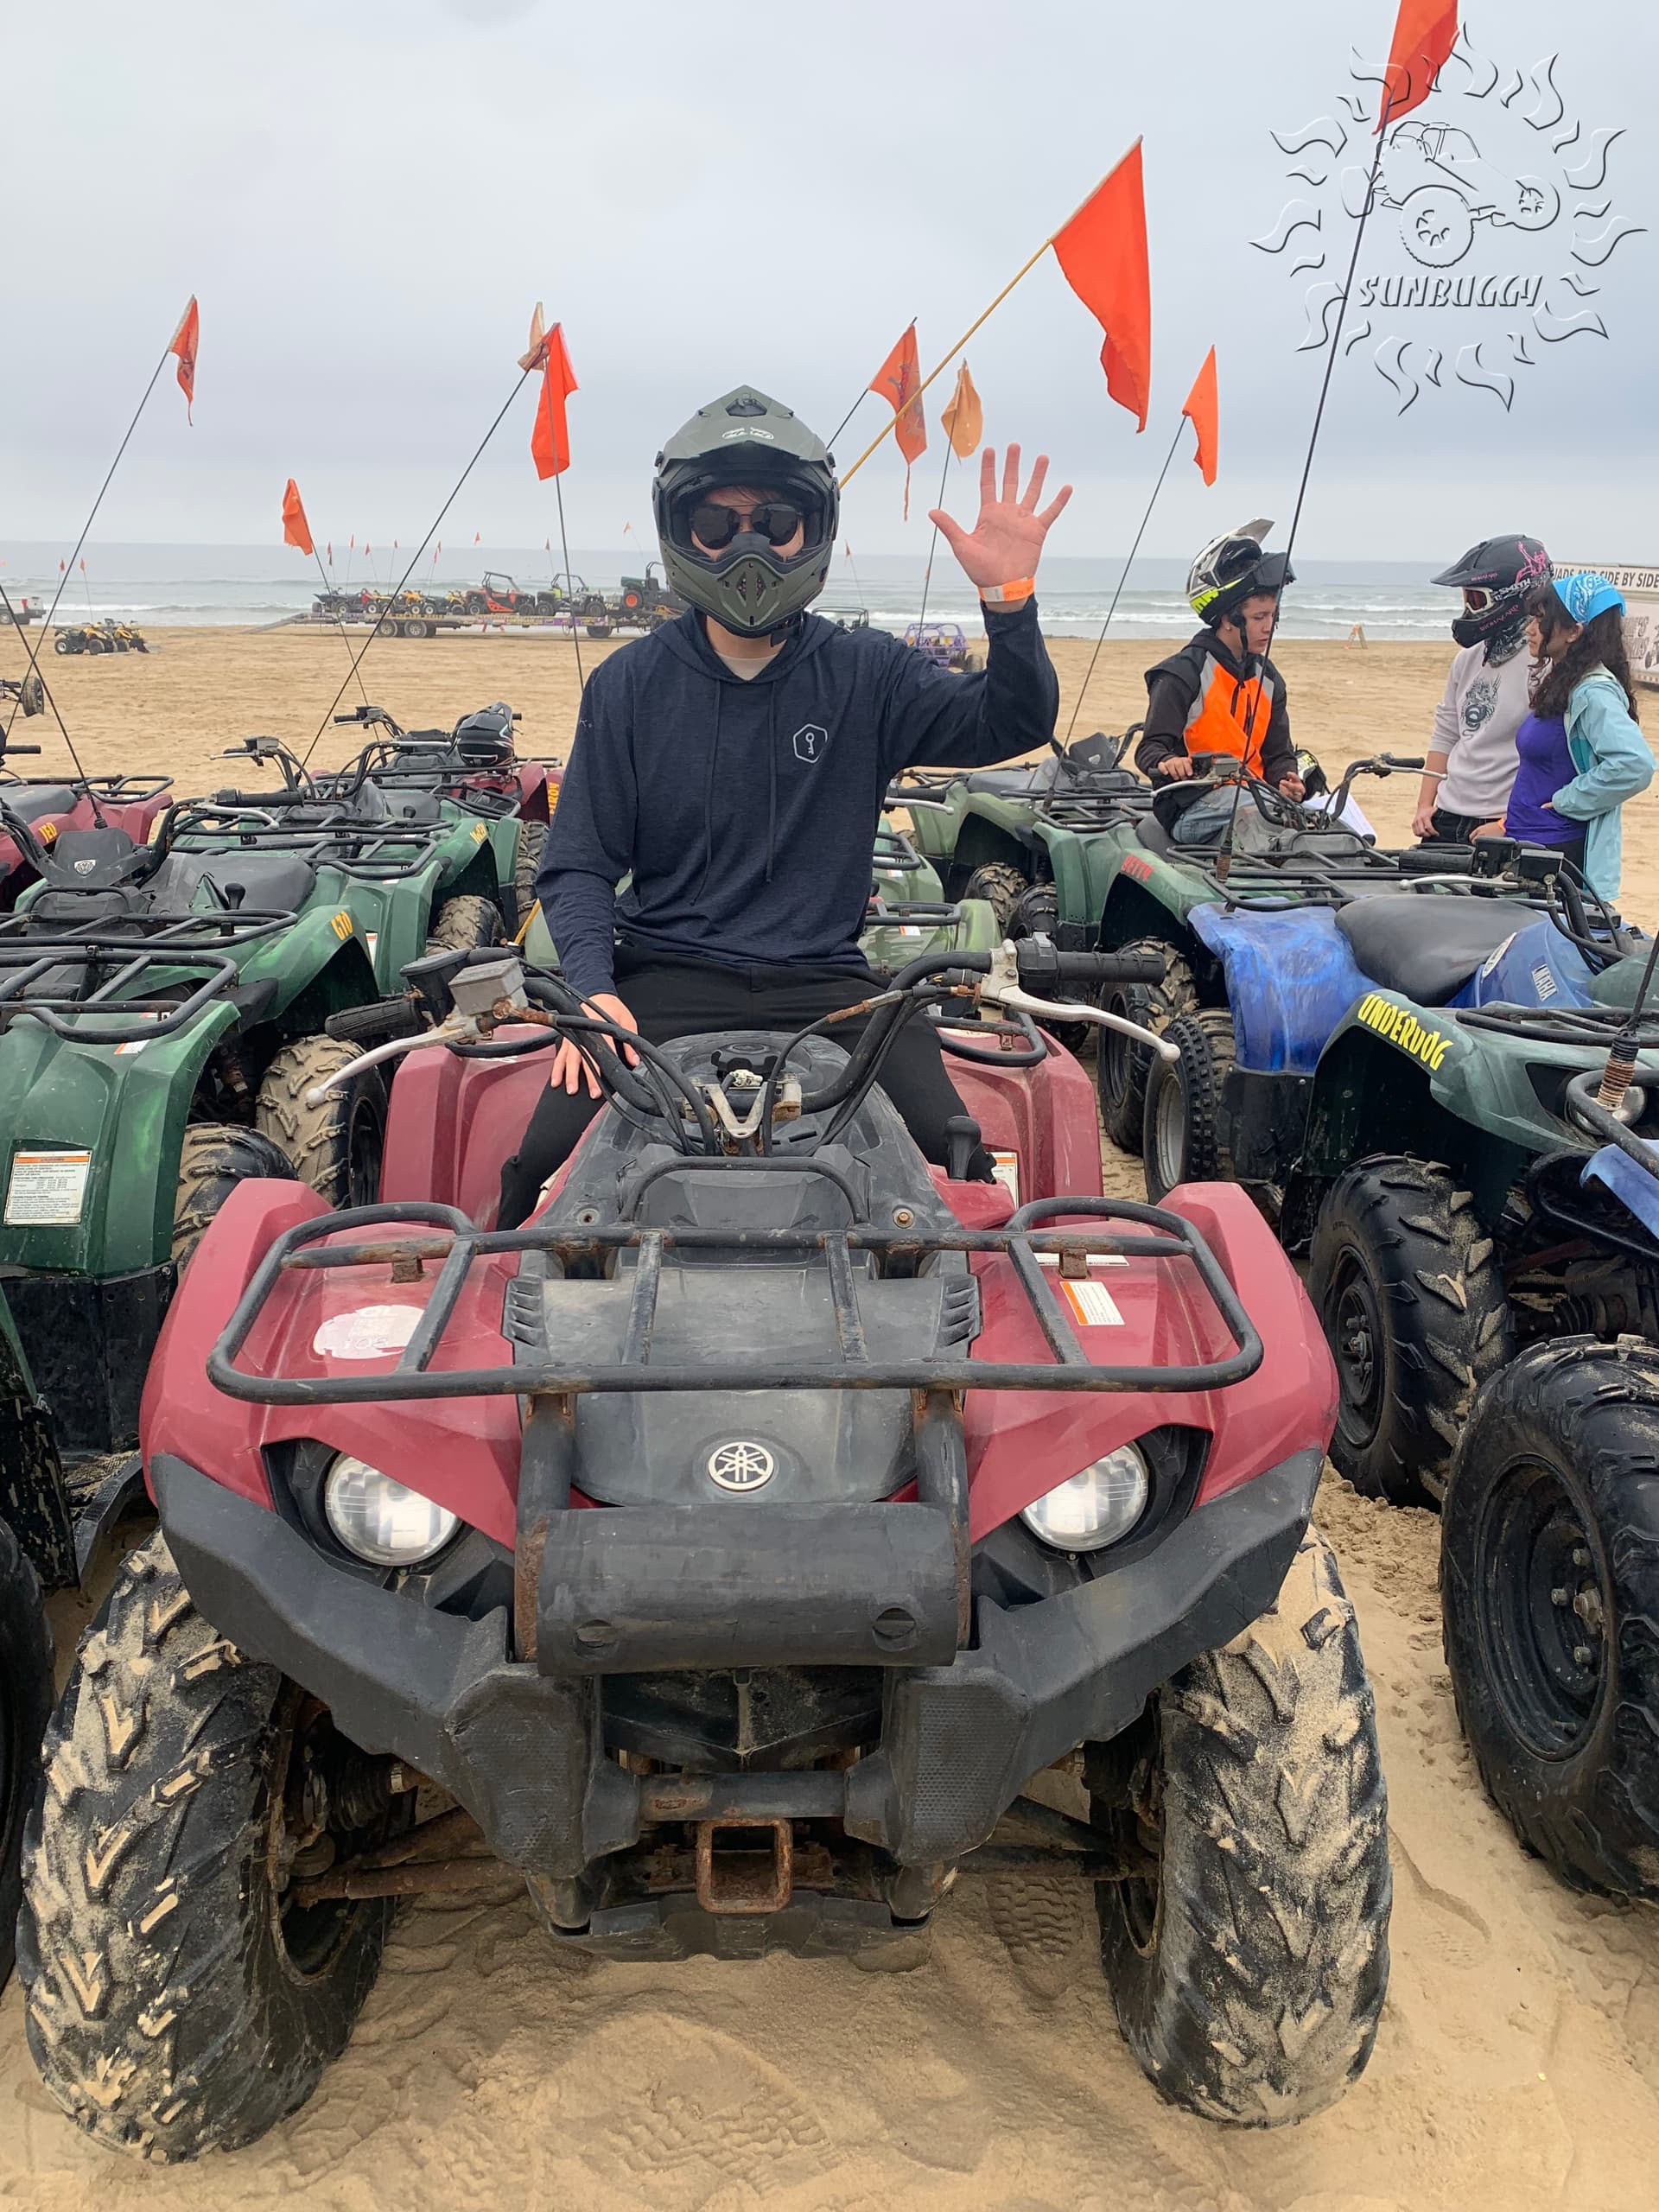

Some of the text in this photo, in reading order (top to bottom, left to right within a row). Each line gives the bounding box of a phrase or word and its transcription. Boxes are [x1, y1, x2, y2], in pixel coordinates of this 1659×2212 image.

[1499, 577, 1531, 594] SMITH
[1622, 574, 1636, 588] BY
[1357, 994, 1454, 1071] UNDERDOG
